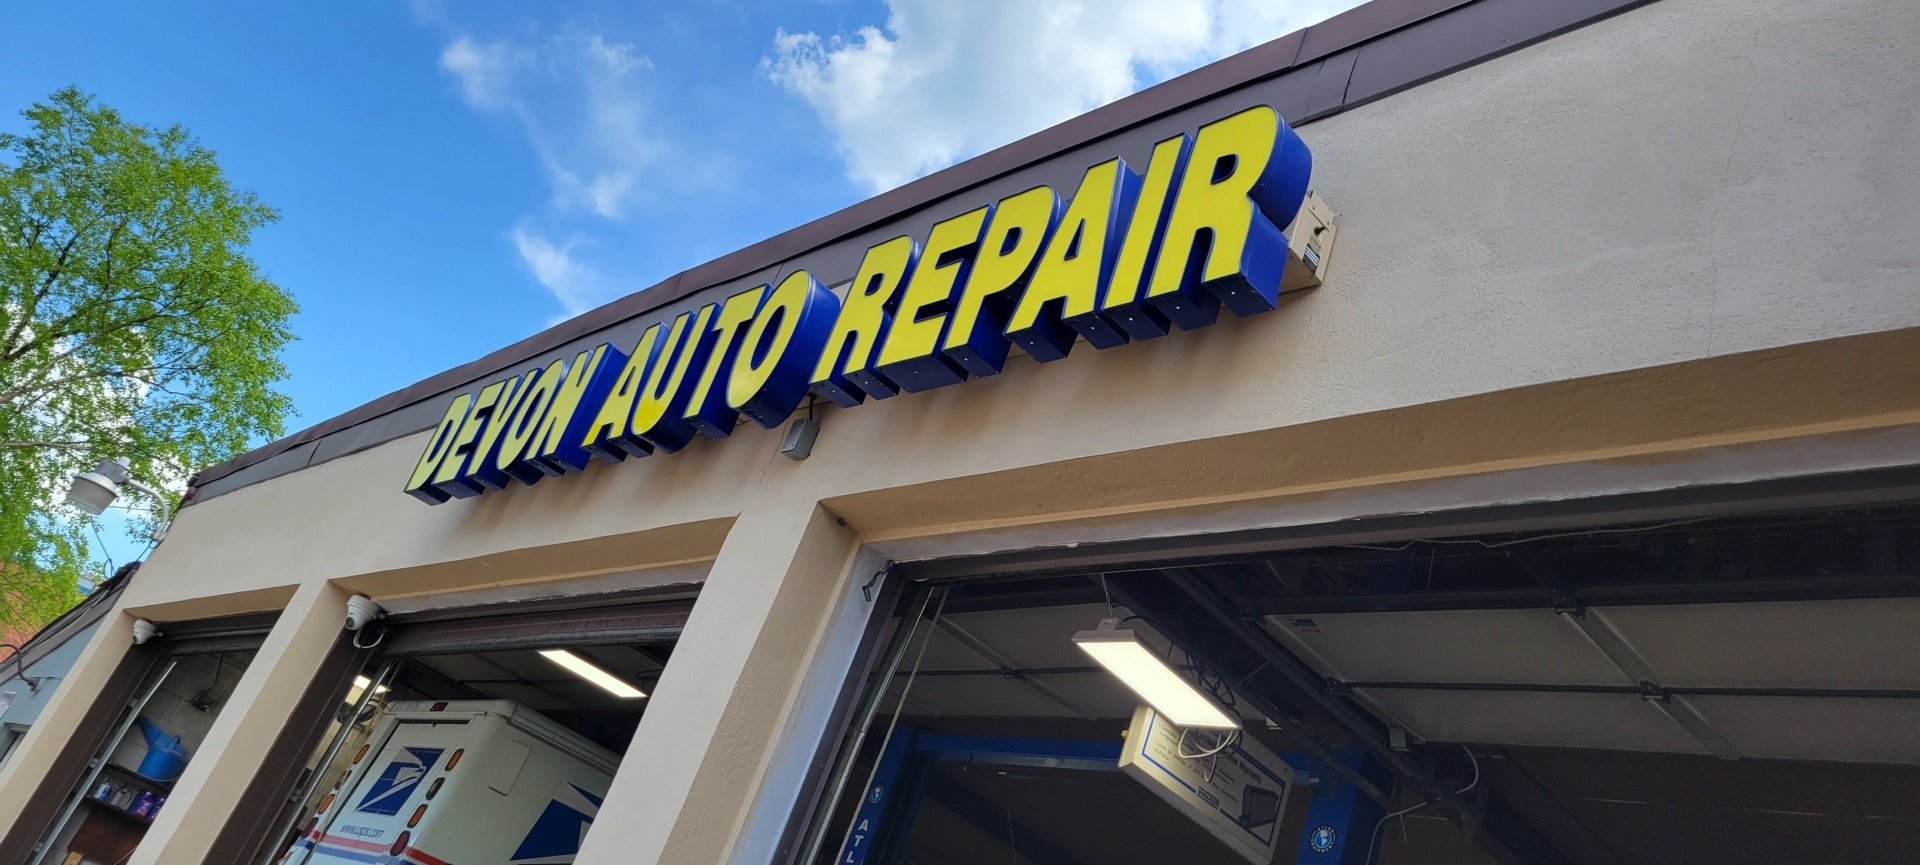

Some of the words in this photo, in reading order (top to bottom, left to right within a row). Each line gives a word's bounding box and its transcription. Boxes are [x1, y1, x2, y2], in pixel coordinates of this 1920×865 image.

[404, 343, 609, 495] DEVON
[581, 268, 816, 449] AUTO
[811, 104, 1280, 388] REPAIR
[1237, 759, 1262, 785] Warranty
[1197, 787, 1220, 808] WALKER
[339, 824, 385, 838] www.usps.com
